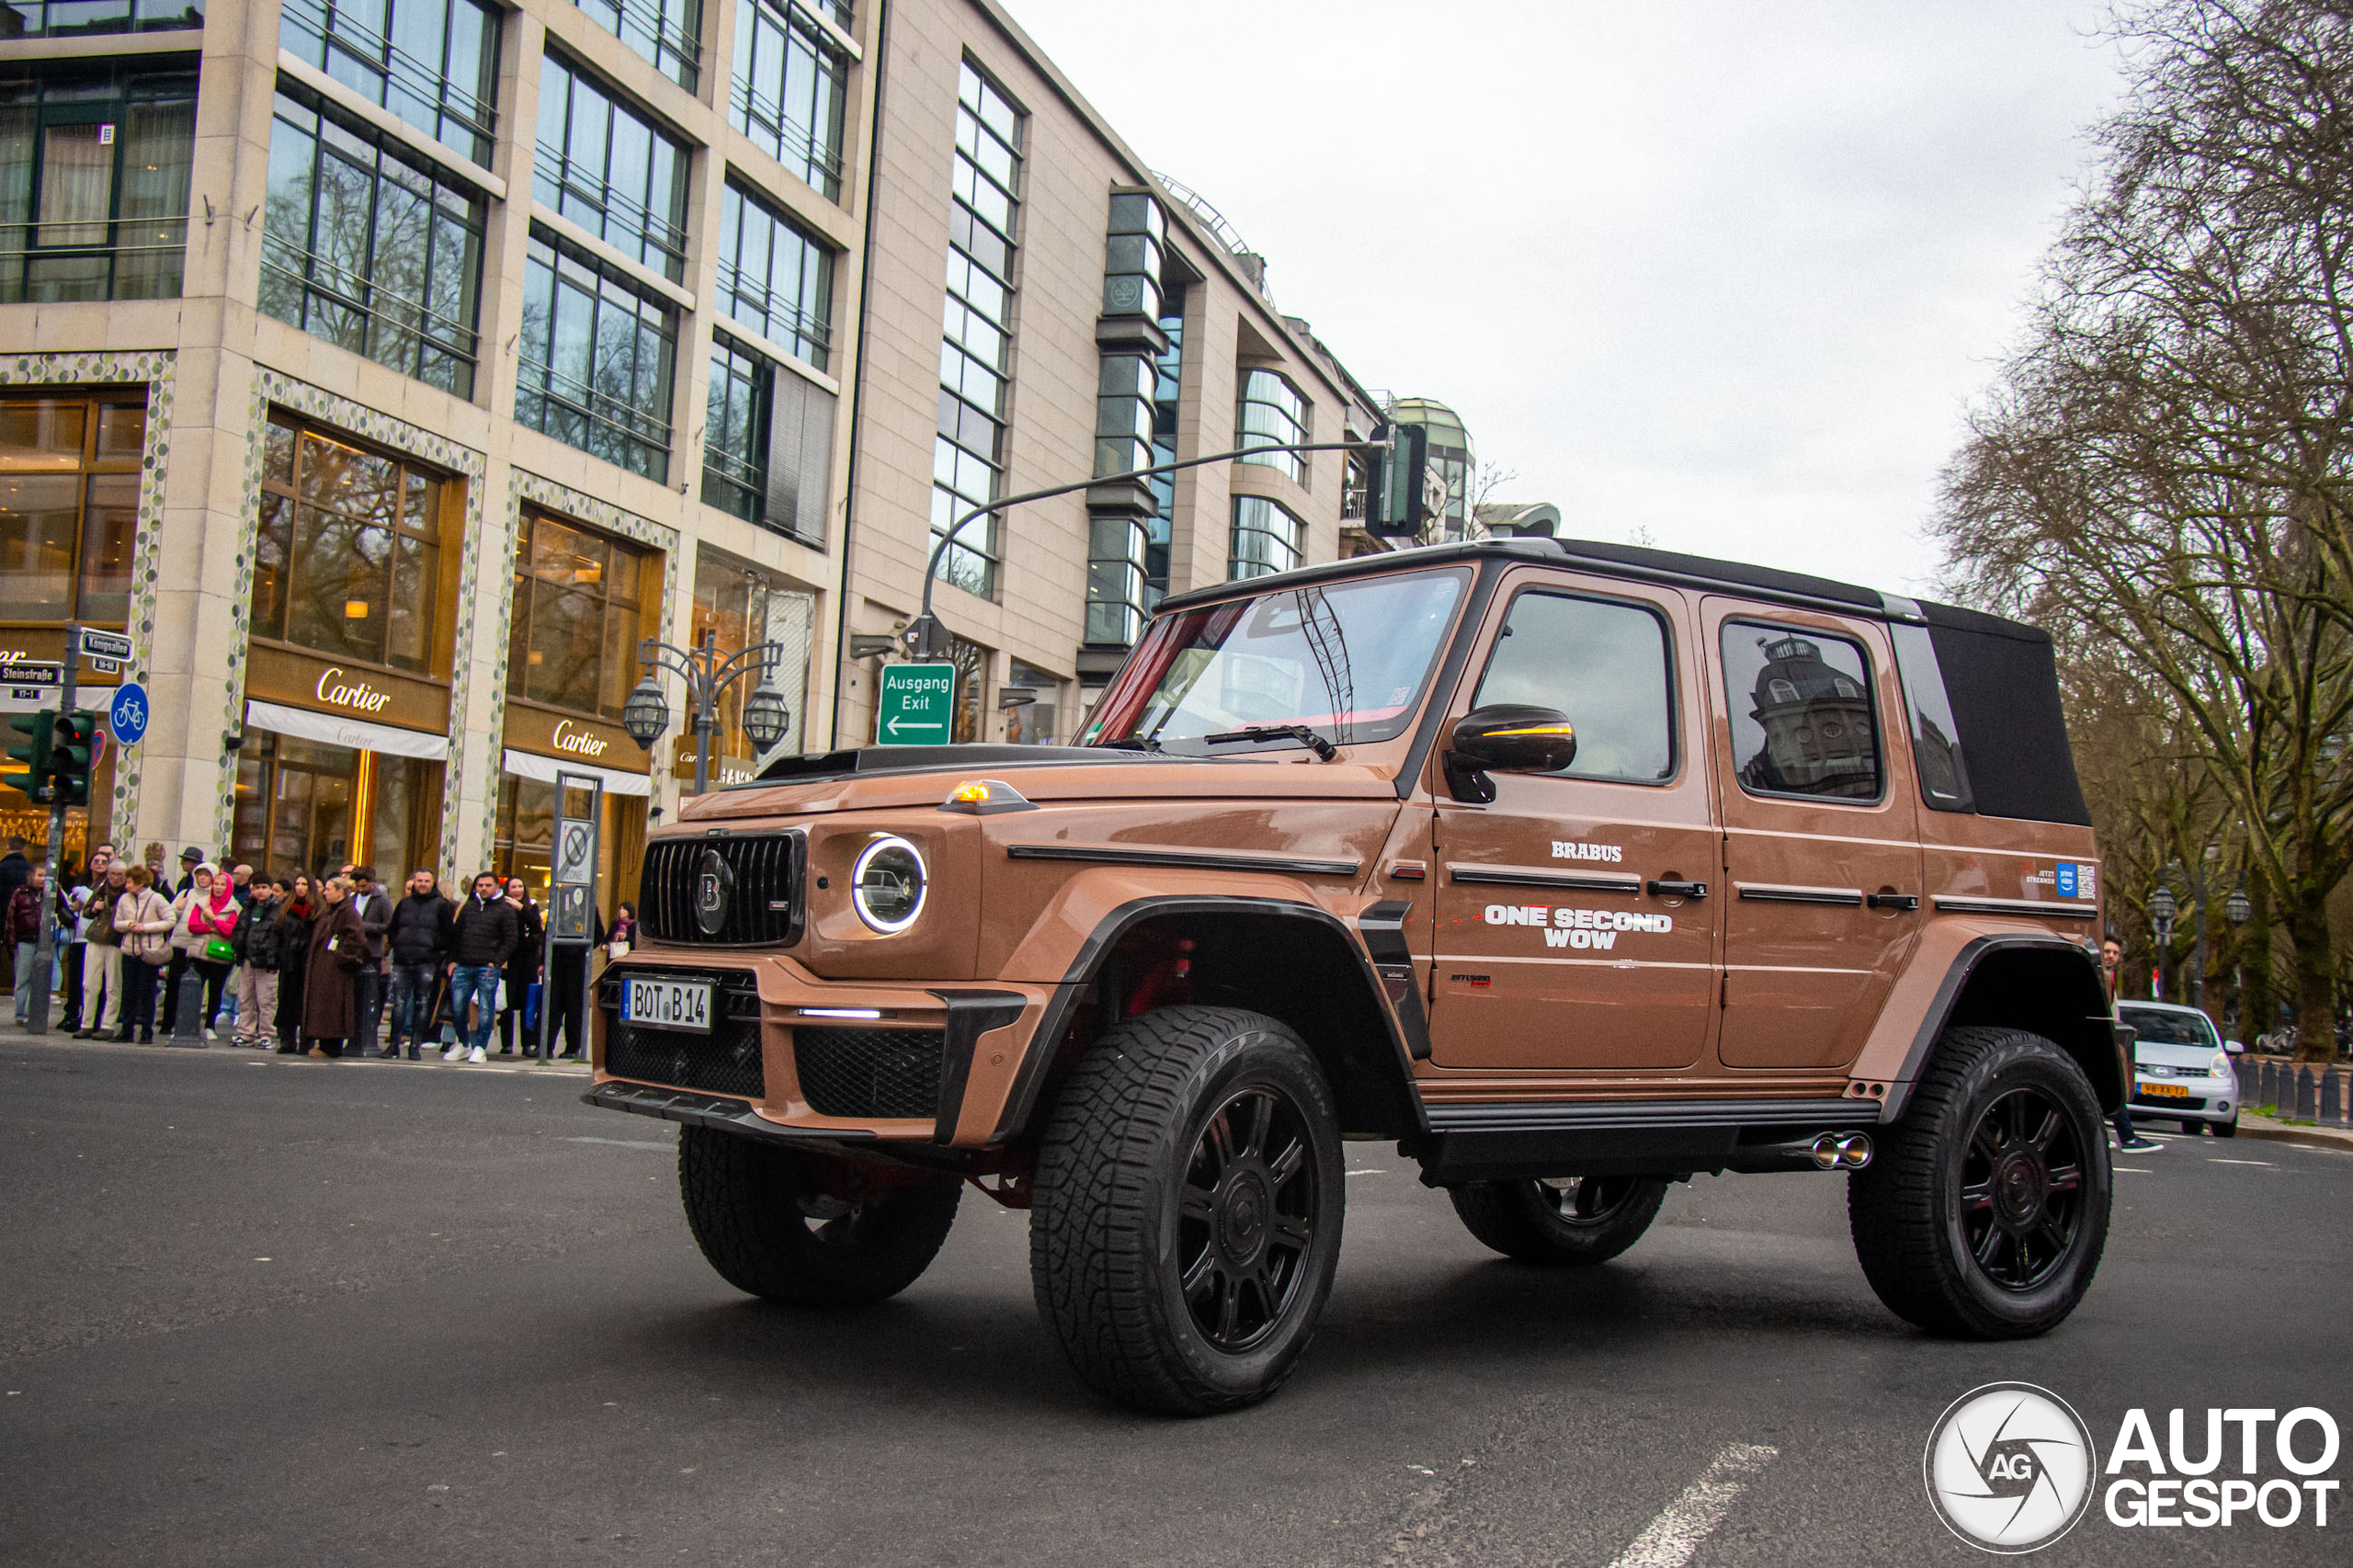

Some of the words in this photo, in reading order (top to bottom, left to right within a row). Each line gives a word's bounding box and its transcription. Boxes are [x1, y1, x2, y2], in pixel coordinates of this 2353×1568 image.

[3, 667, 53, 681] Steinstraße
[886, 675, 949, 693] Ausgang
[316, 667, 391, 712] Cartier
[902, 695, 930, 710] Exit
[336, 726, 375, 748] Cartier
[552, 719, 608, 756] Cartier
[1552, 841, 1622, 862] BRABUS
[1484, 904, 1547, 926] ONE
[1554, 908, 1672, 933] SECOND
[1543, 928, 1617, 949] WOW
[635, 983, 663, 1018] BOT
